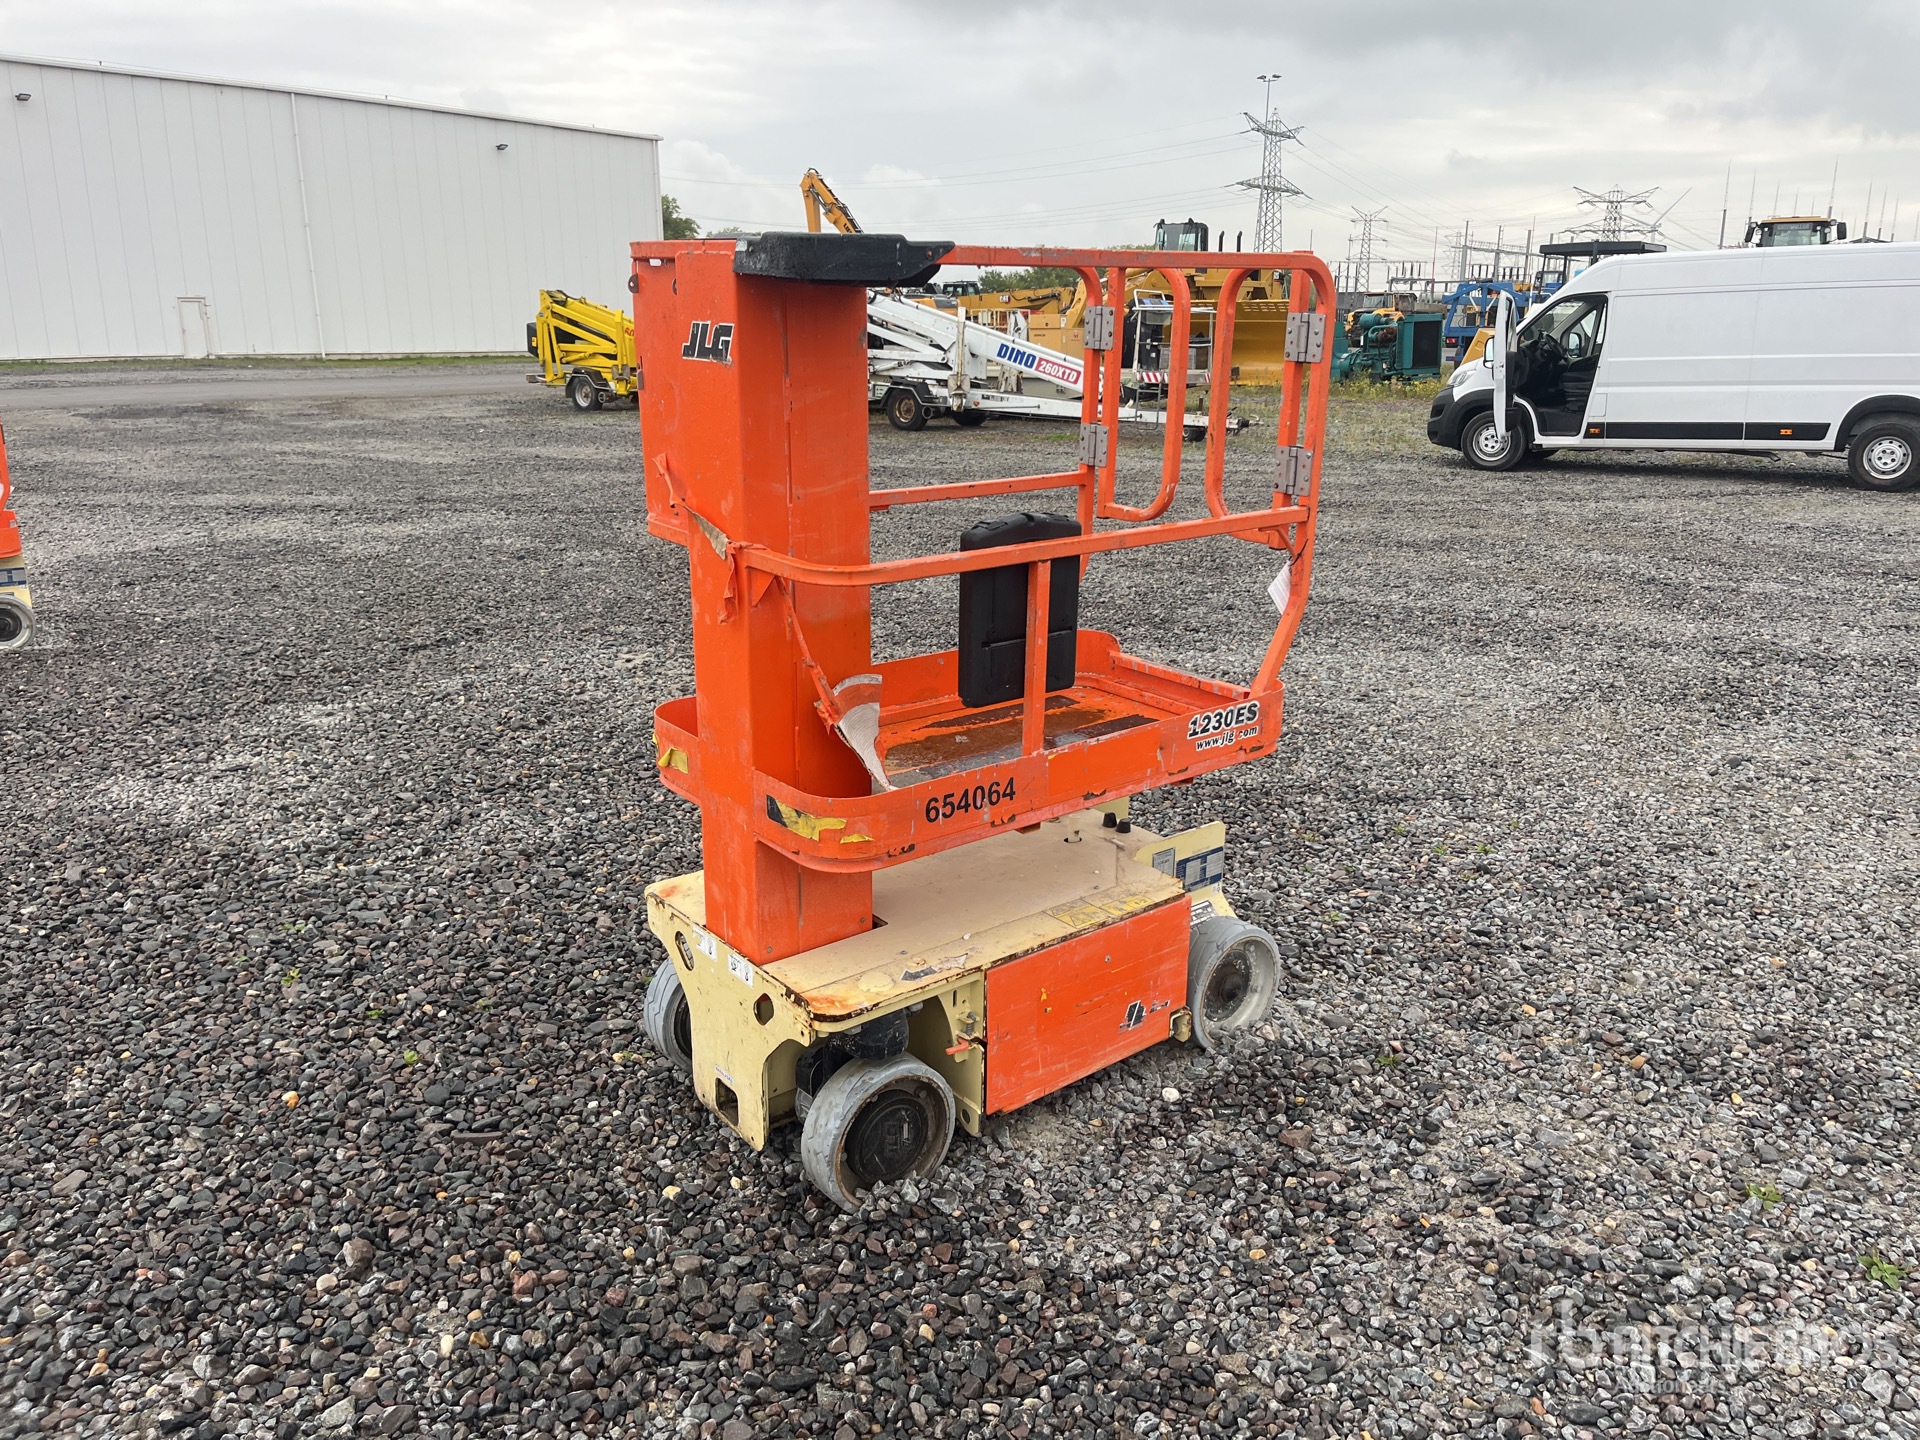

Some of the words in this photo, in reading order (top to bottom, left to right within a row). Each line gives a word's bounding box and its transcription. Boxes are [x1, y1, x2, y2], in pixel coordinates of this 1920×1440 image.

[682, 321, 734, 363] JLG
[997, 343, 1037, 369] DINO
[1038, 360, 1078, 383] 260XTD
[1188, 702, 1258, 738] 1230ES
[1196, 726, 1258, 750] www.jlgcom
[925, 777, 1016, 823] 654064
